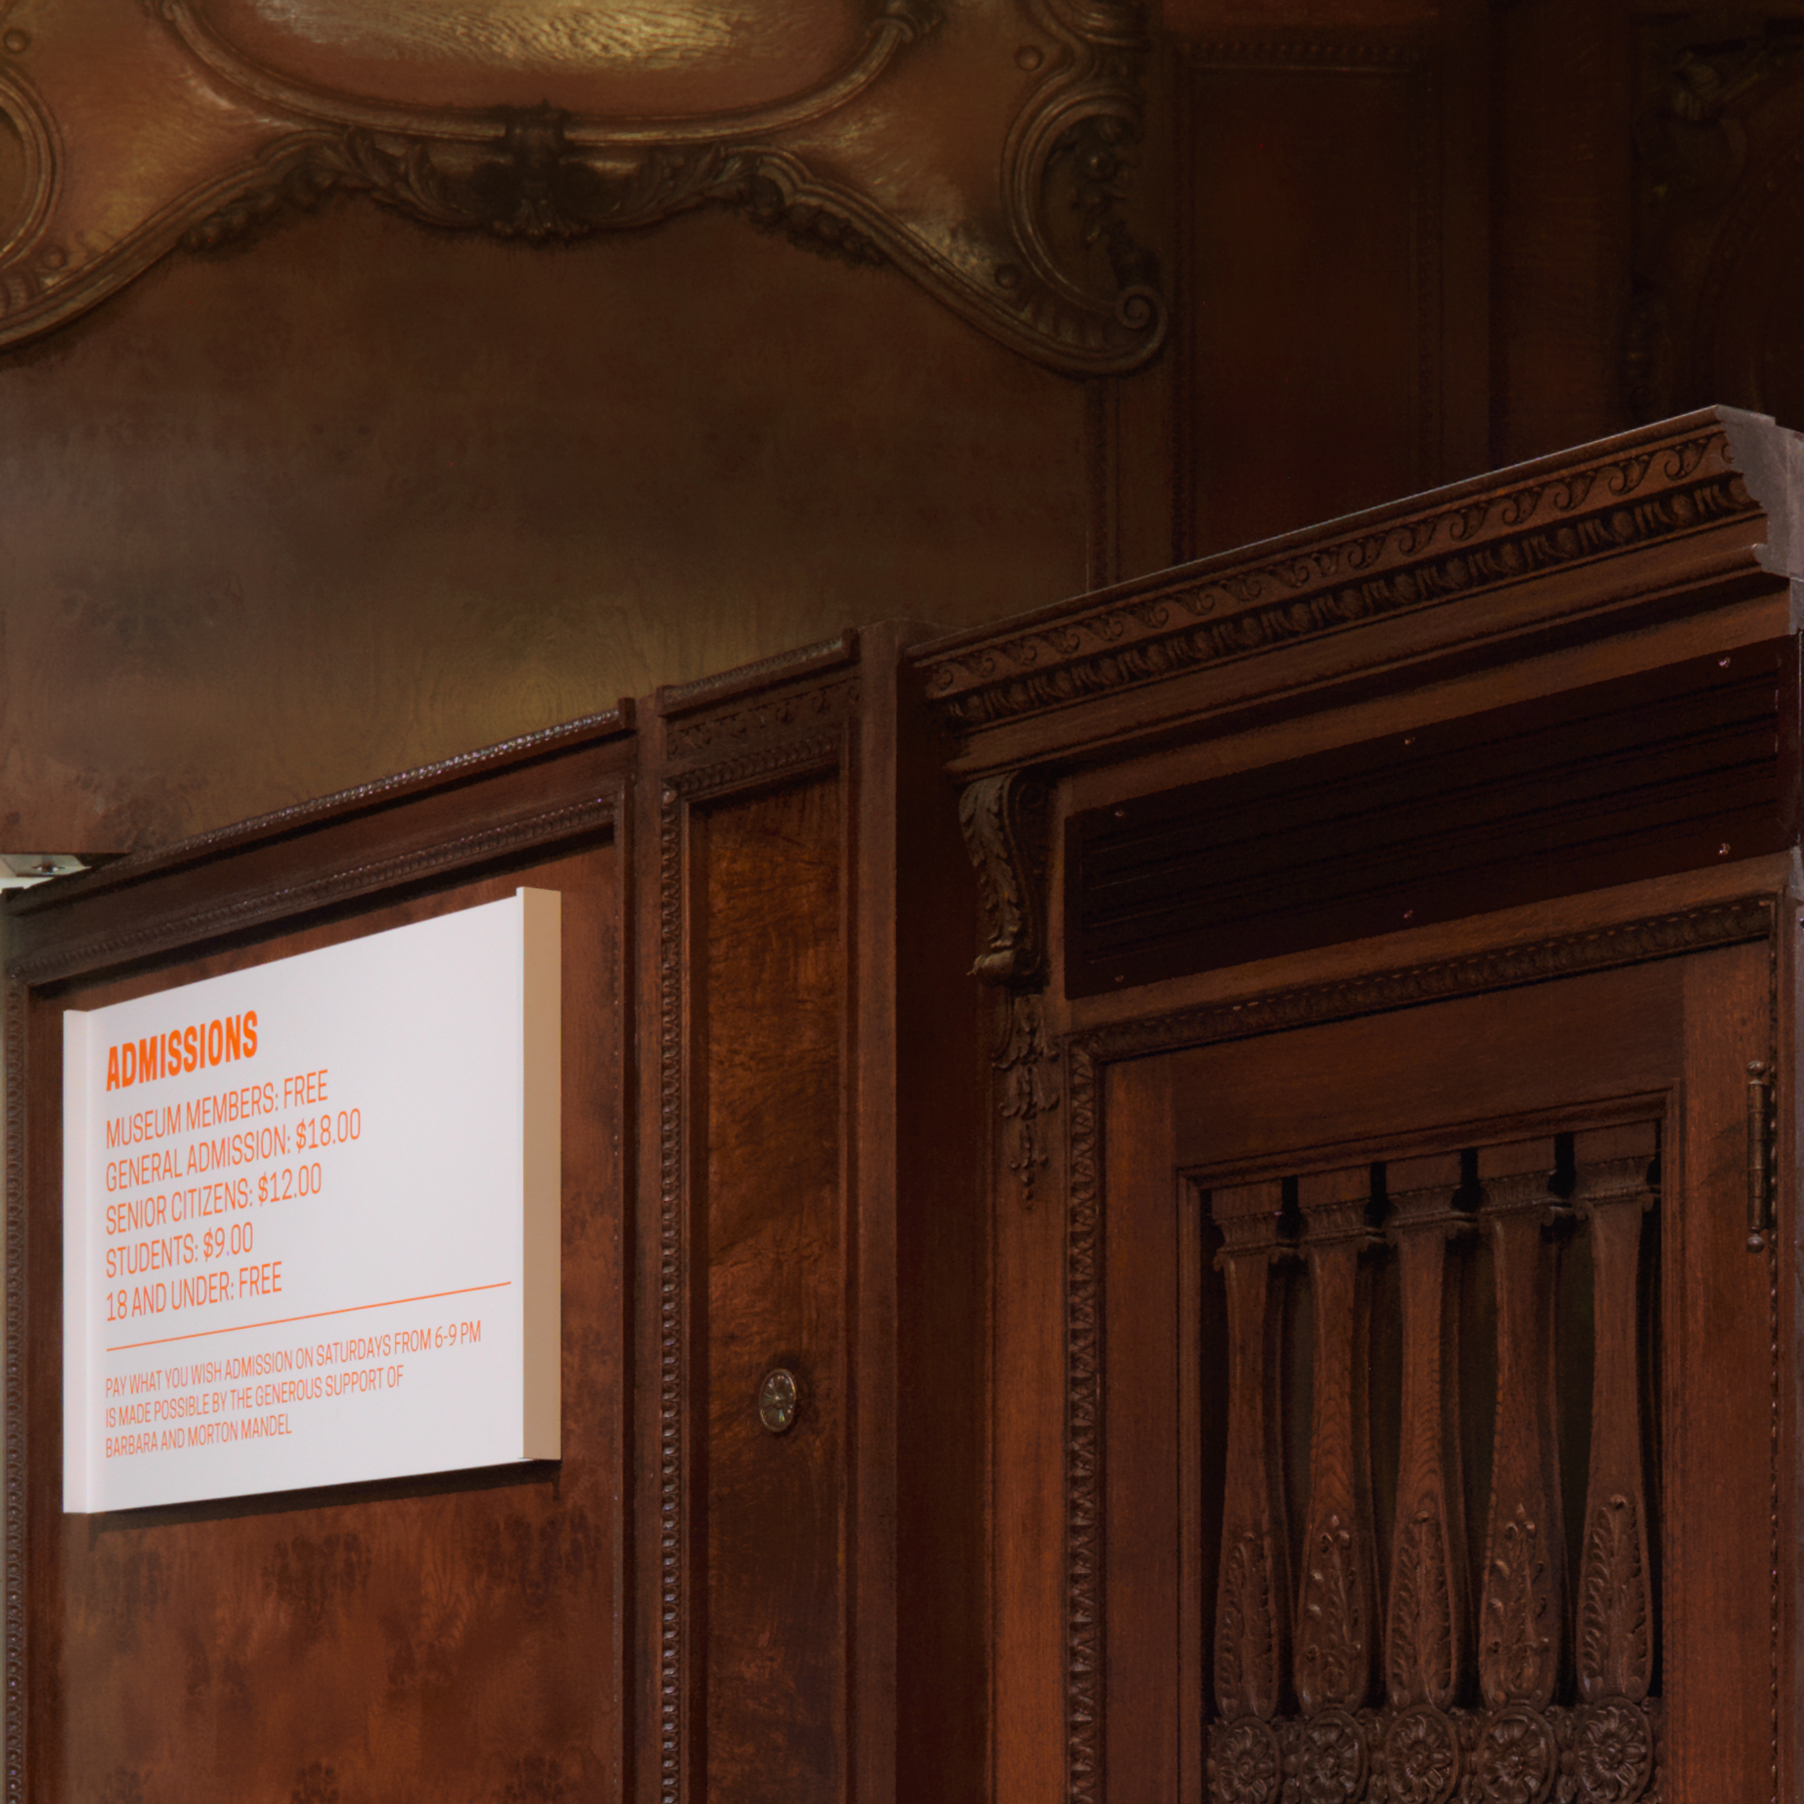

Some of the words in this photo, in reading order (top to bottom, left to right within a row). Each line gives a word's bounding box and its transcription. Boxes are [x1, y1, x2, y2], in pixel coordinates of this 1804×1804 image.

[106, 1009, 258, 1092] ADMISSIONS
[106, 1104, 182, 1150] MUSEUM
[186, 1082, 278, 1132] MEMBERS:
[283, 1069, 329, 1109] FREE
[106, 1148, 183, 1193] GENERAL
[186, 1124, 291, 1176] ADMISSION:
[295, 1108, 361, 1153] $18.00
[106, 1195, 167, 1236] SENIOR
[171, 1178, 253, 1222] CITIZENS:
[258, 1162, 322, 1206] $12.00
[106, 1233, 199, 1279] STUDENTS:
[202, 1222, 254, 1262] $9.00
[106, 1289, 128, 1322] 18
[131, 1283, 167, 1318] AND
[171, 1271, 235, 1311] UNDER:
[238, 1261, 283, 1298] FREE
[106, 1375, 128, 1398] PAY
[129, 1370, 162, 1395] WHAT
[165, 1367, 188, 1389] YOU
[191, 1361, 222, 1385] WISH
[224, 1350, 293, 1380] ADMISSION
[296, 1346, 314, 1370] ON
[316, 1334, 391, 1366] SATURDAYS
[394, 1328, 432, 1354] FROM
[435, 1323, 457, 1348] 6-9
[460, 1320, 481, 1344] PM
[106, 1407, 117, 1429] IS
[119, 1402, 151, 1426] MADE
[154, 1393, 210, 1422] POSSIBLE
[212, 1391, 228, 1413] BY
[230, 1387, 253, 1410] THE
[255, 1376, 323, 1407] GENEROUS
[325, 1367, 384, 1397] SUPPORT
[387, 1365, 404, 1388] OF
[106, 1431, 158, 1458] BARBARA
[161, 1428, 185, 1451] AND
[188, 1420, 238, 1448] MORTON
[241, 1413, 293, 1440] MANDEL
